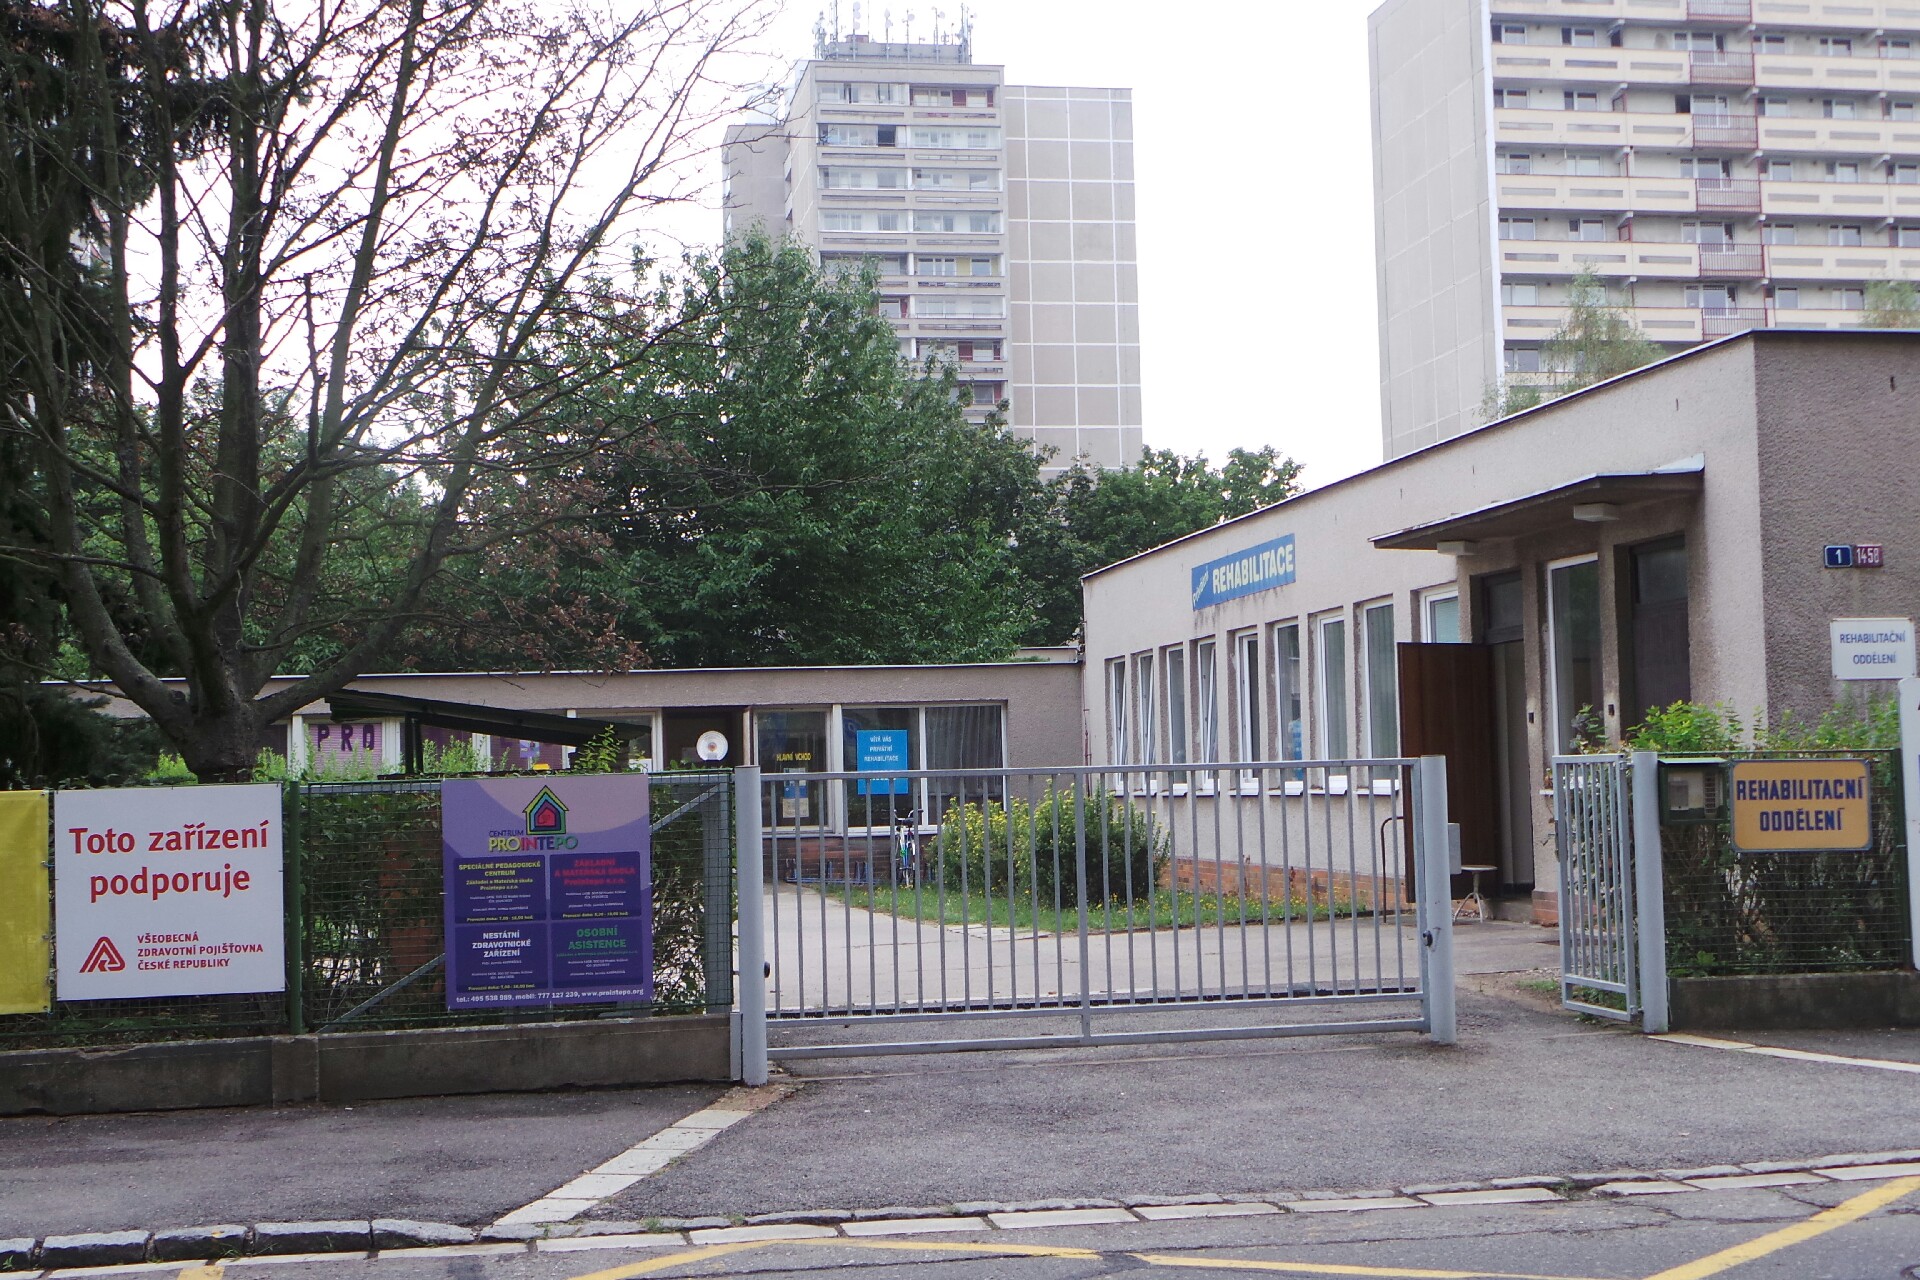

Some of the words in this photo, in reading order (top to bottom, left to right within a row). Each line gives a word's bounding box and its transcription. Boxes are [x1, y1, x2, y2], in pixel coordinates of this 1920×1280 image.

[1835, 549, 1842, 564] 1
[1856, 548, 1880, 564] 1458
[1212, 544, 1294, 595] REHABILITACE
[794, 752, 812, 762] VCHOD
[1759, 807, 1846, 832] ODDĚLENÍ
[69, 828, 136, 855] Toto
[148, 820, 270, 852] zařízení
[489, 830, 524, 838] CENTRUM
[488, 836, 579, 852] PROINTEPO
[484, 869, 516, 877] CENTRUM
[90, 863, 250, 904] podporuje
[137, 931, 199, 944] VŠEOBECNÁ
[482, 930, 520, 940] NESTÁTNÍ
[576, 925, 618, 938] OSOBNÍ
[137, 946, 197, 957] ZDRAVOTNÍ
[199, 943, 264, 955] POJIŠŤOVNA
[472, 939, 531, 949] ZDRAVOTNICKÉ
[568, 939, 627, 950] ASISTENCE
[483, 949, 520, 958] ZAŘÍZENÍ
[138, 959, 171, 971] ČESKÉ
[173, 958, 231, 969] REPUBLIKY
